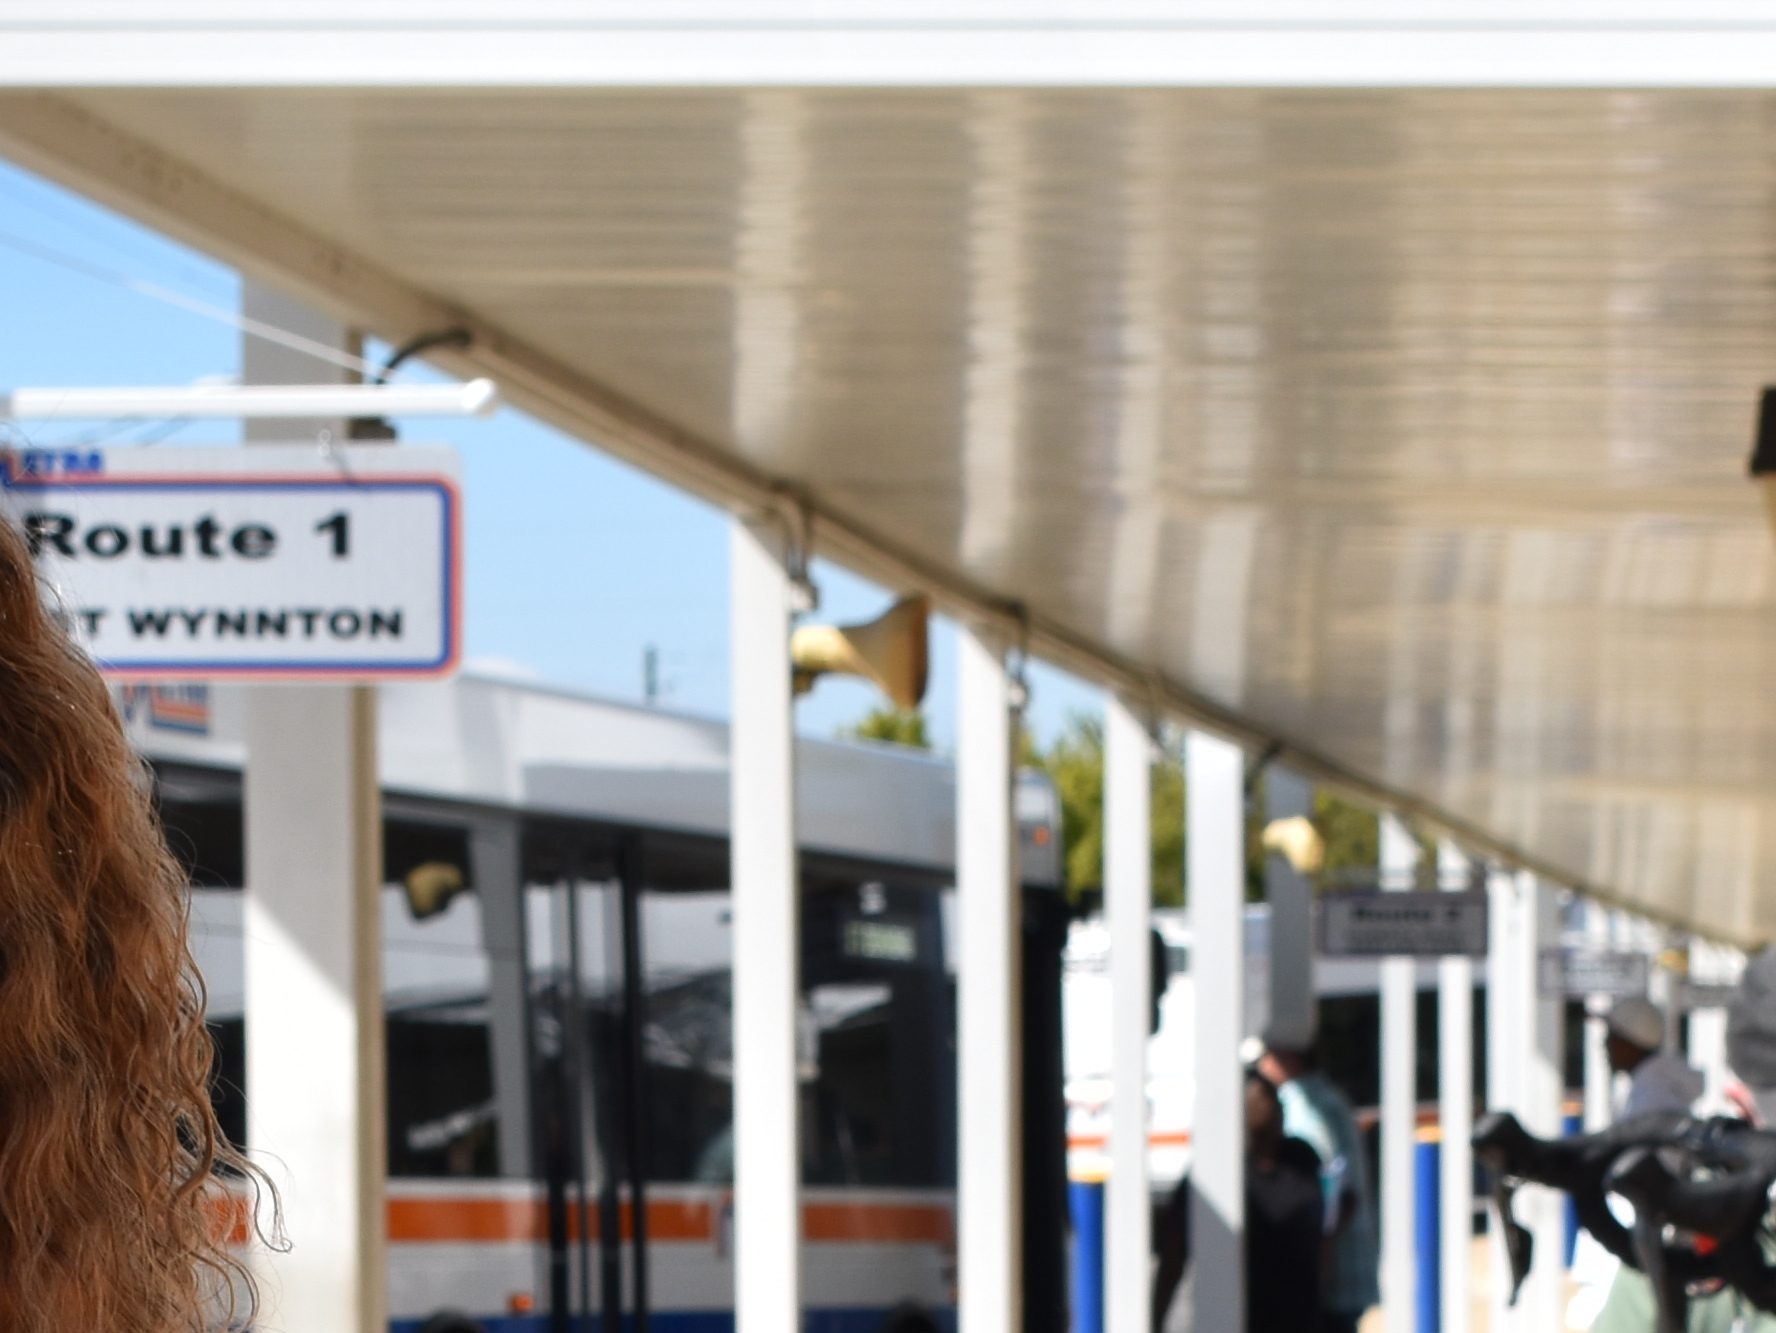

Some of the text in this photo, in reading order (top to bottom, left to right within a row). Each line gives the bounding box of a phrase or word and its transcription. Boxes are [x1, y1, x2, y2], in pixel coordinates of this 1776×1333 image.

[25, 510, 351, 559] Route 1
[128, 607, 405, 640] WYNNTON
